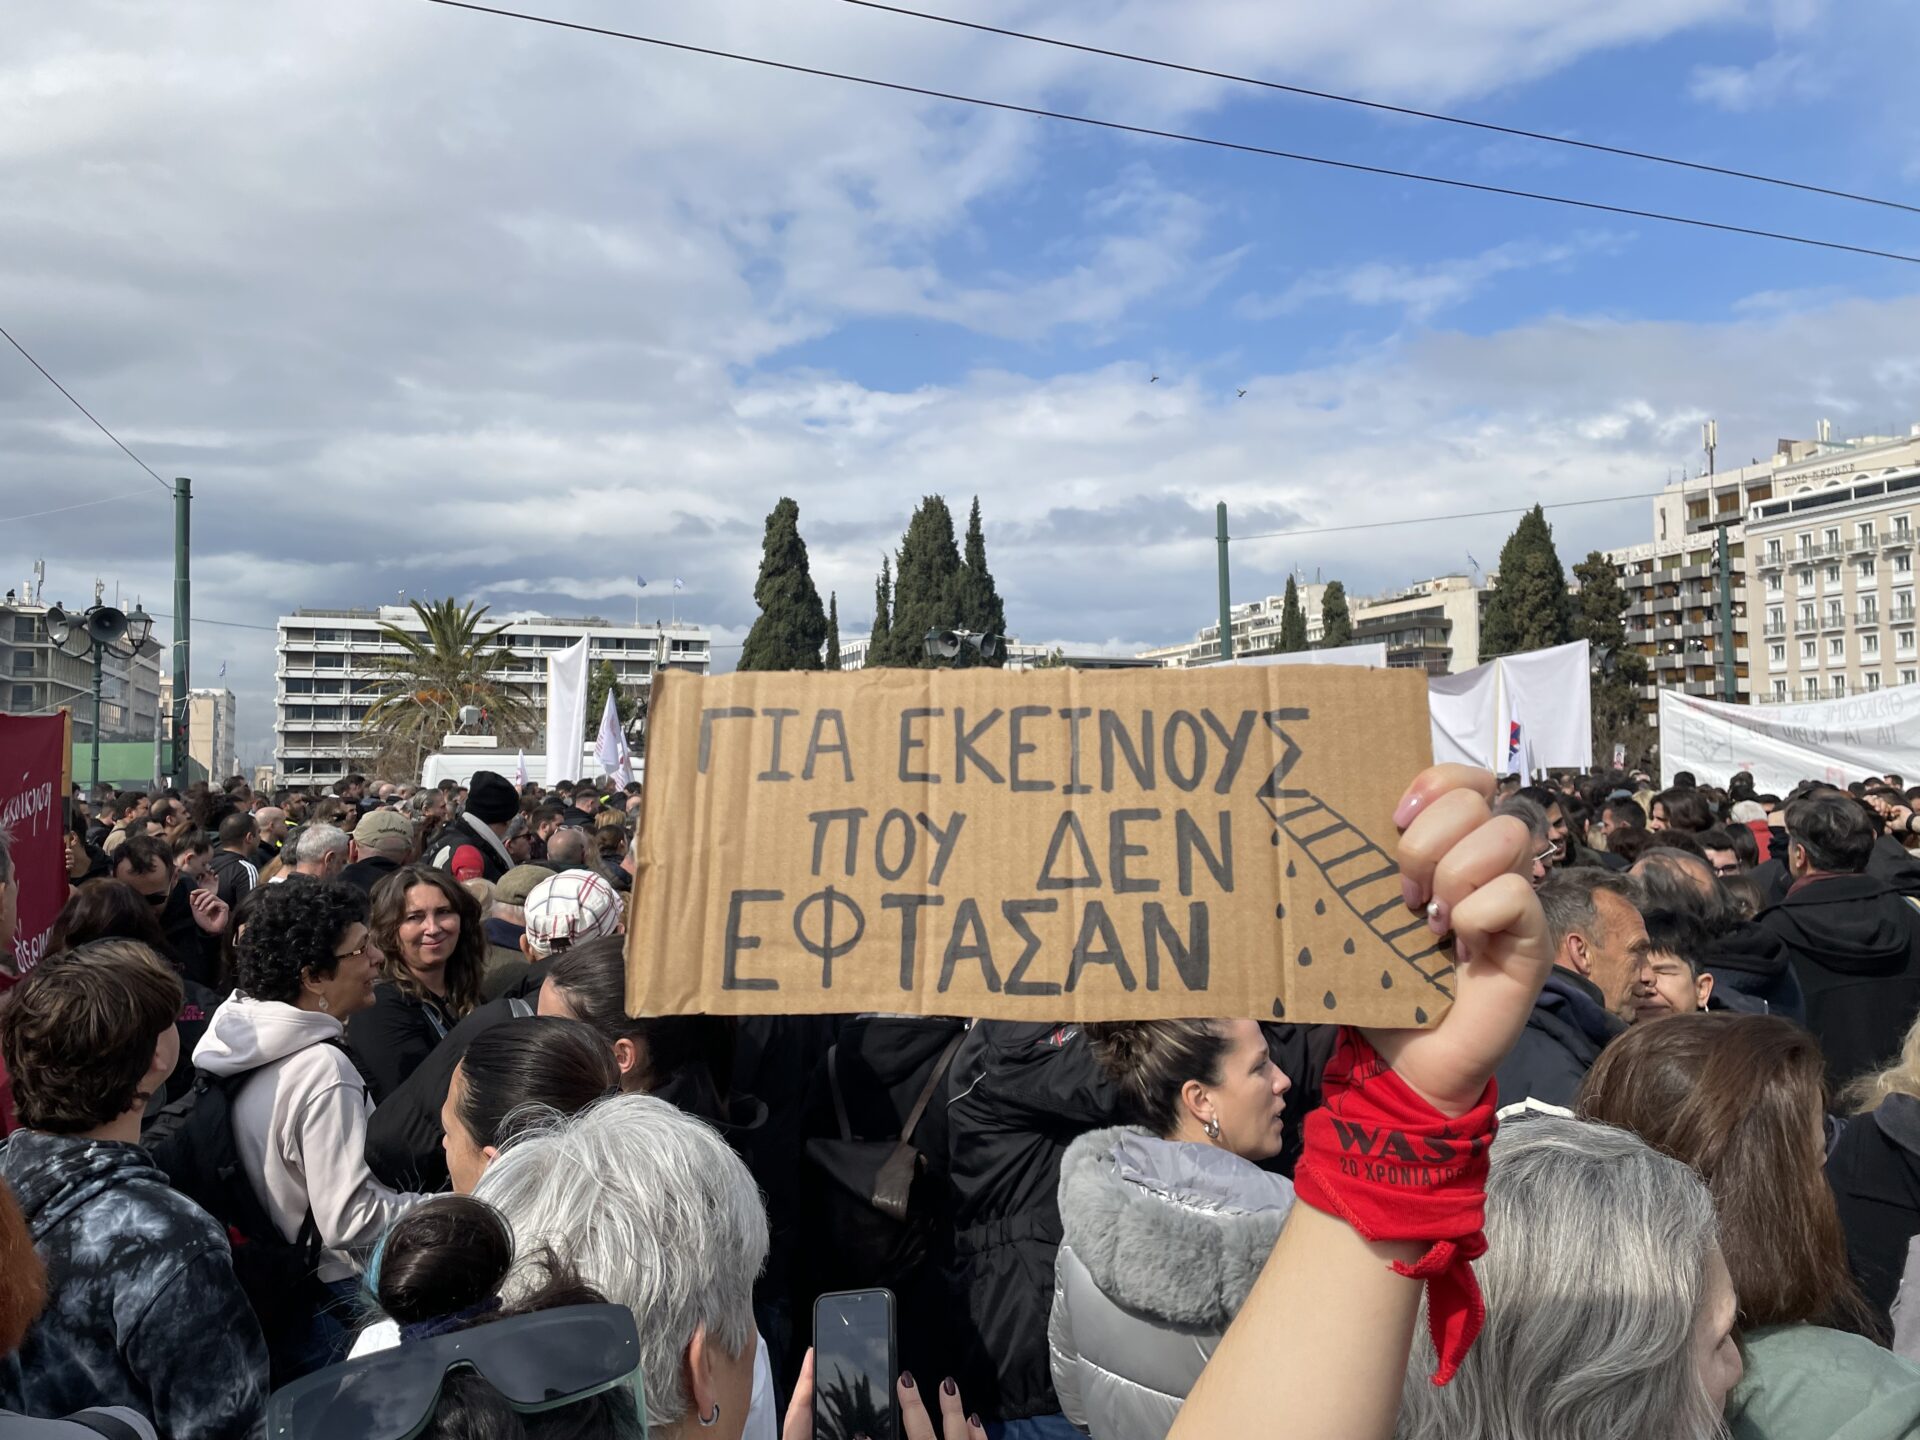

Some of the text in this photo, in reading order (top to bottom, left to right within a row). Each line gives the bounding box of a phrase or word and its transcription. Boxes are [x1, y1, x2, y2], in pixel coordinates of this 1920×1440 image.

[699, 705, 1310, 798] ΓΙΑ ΕΚΕΙΝΟΥΣ
[808, 807, 1235, 895] ΠΟΥ ΔΕΝ
[722, 886, 1209, 995] ΕΦΤΑΣΑΝ
[1340, 1156, 1358, 1177] 20
[1365, 1161, 1432, 1186] ΧΡΟΝΙΑ
